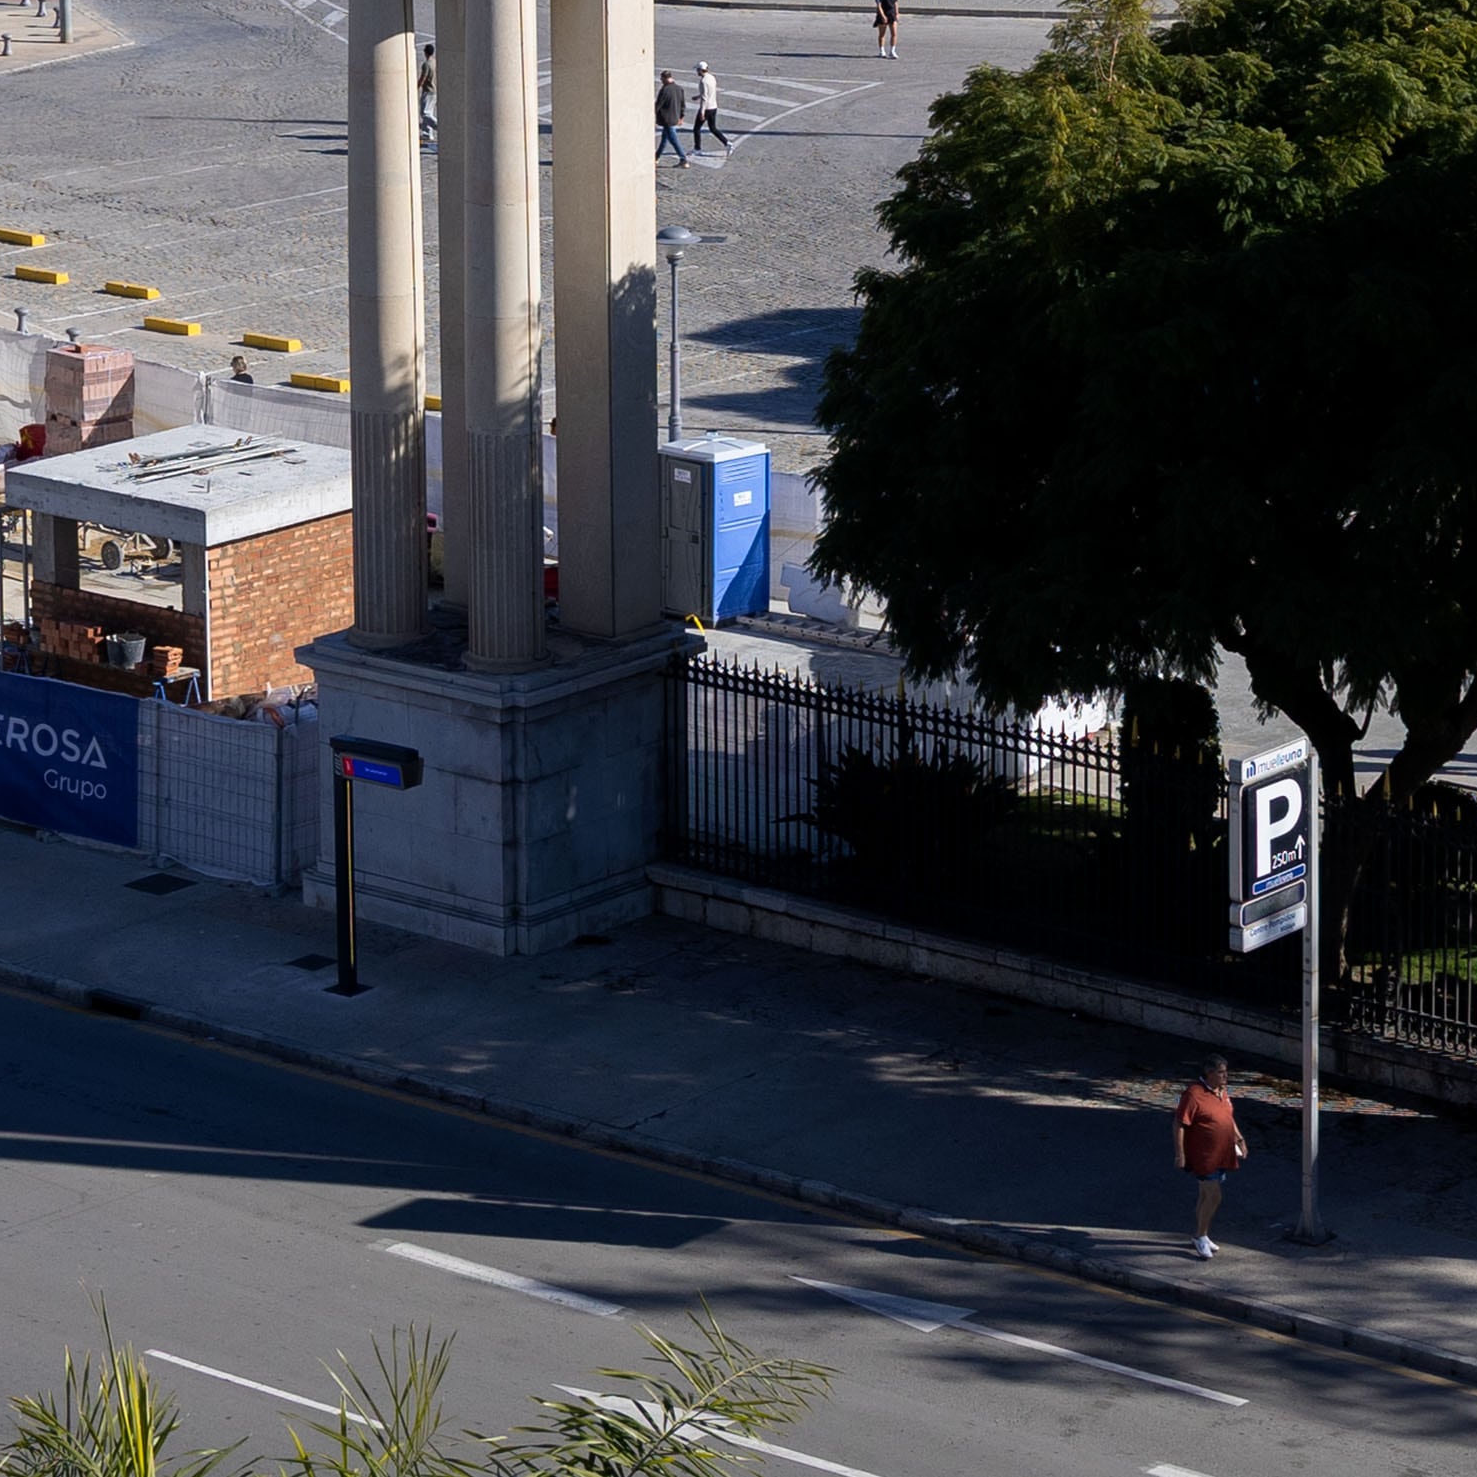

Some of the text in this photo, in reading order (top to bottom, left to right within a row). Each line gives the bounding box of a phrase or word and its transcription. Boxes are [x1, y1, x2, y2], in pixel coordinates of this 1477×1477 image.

[1256, 748, 1303, 775] muelleuno
[43, 768, 107, 800] Grupo
[1256, 778, 1303, 878] P
[1272, 850, 1296, 870] 250m
